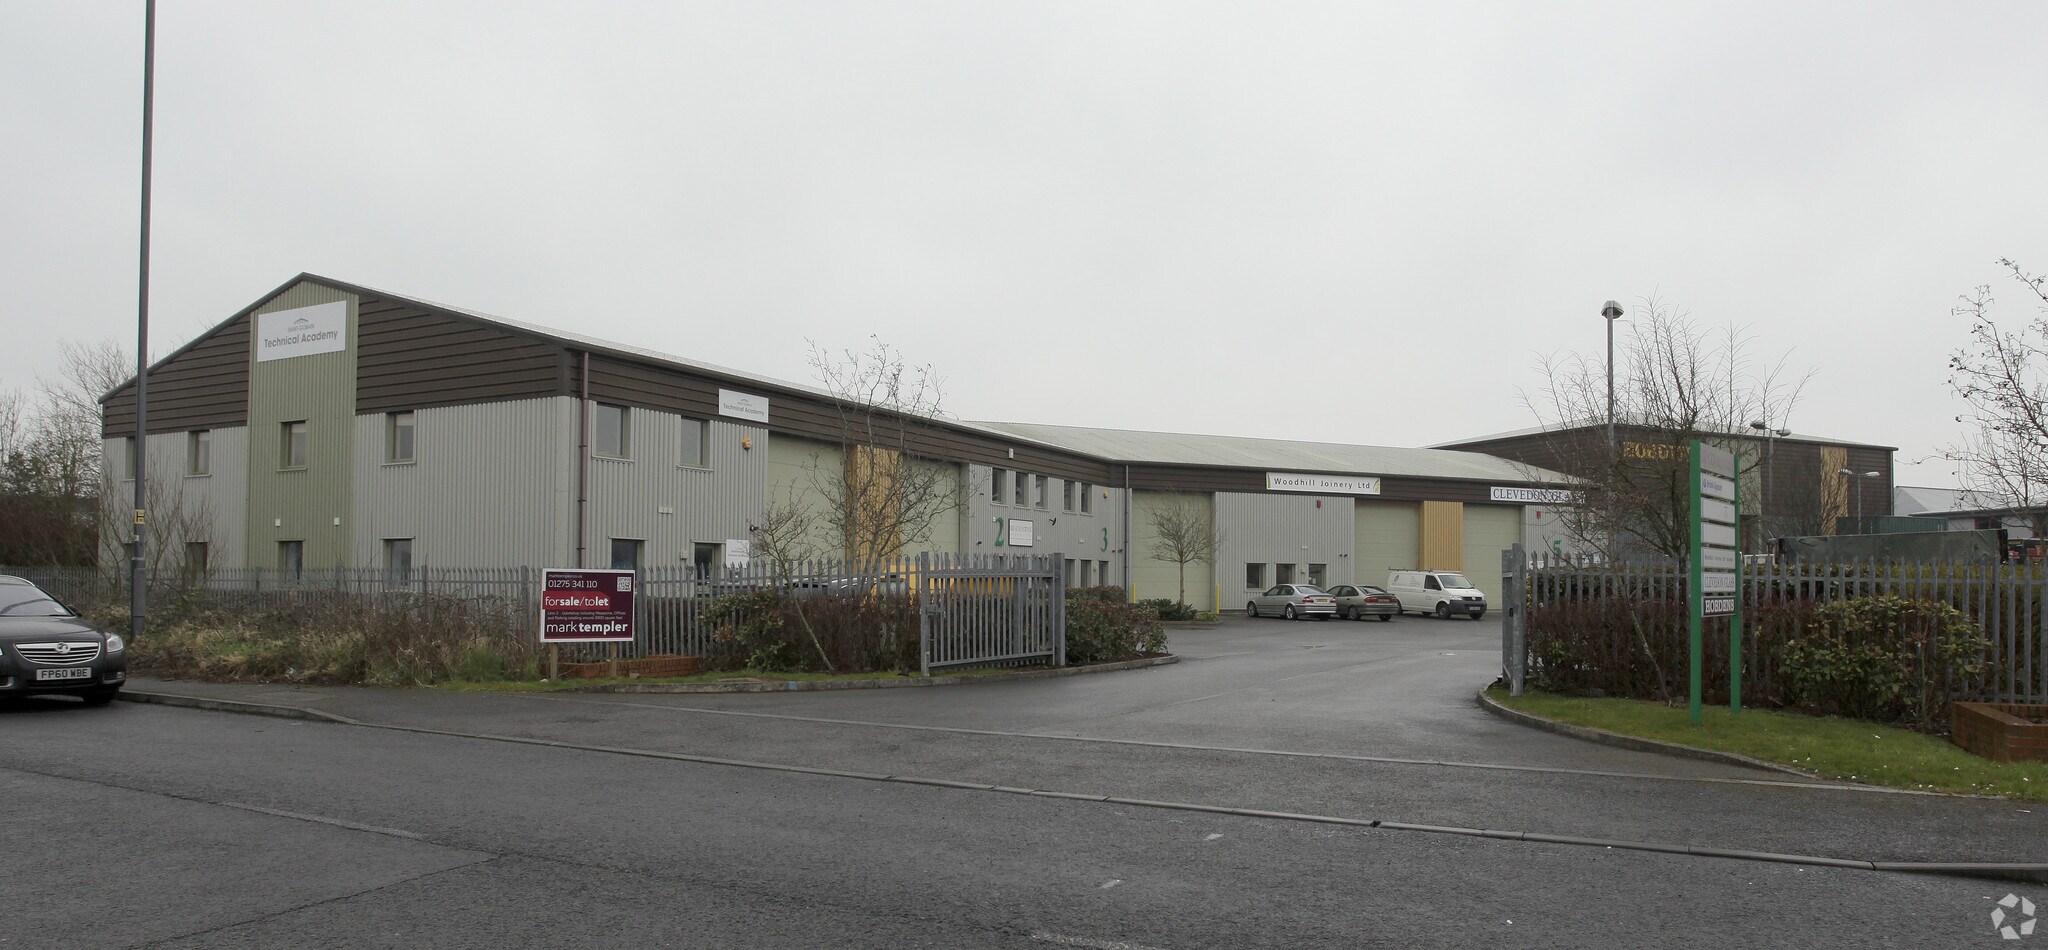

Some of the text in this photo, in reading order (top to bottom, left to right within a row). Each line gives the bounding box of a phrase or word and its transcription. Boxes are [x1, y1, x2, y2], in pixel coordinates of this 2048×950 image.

[264, 330, 338, 348] Technical Academy
[723, 402, 745, 412] Technical
[745, 407, 765, 417] Academy
[1274, 477, 1315, 487] Woodhill
[1320, 480, 1353, 490] Joinery
[1493, 488, 1549, 501] CLEVEDON
[994, 516, 1005, 547] 2
[1100, 527, 1108, 552] 3
[1553, 539, 1562, 555] 5
[548, 580, 598, 588] 01275 341 110
[1705, 599, 1735, 613] HOBDENS
[546, 621, 628, 635] mark templer
[41, 668, 88, 679] FP60 WBE
